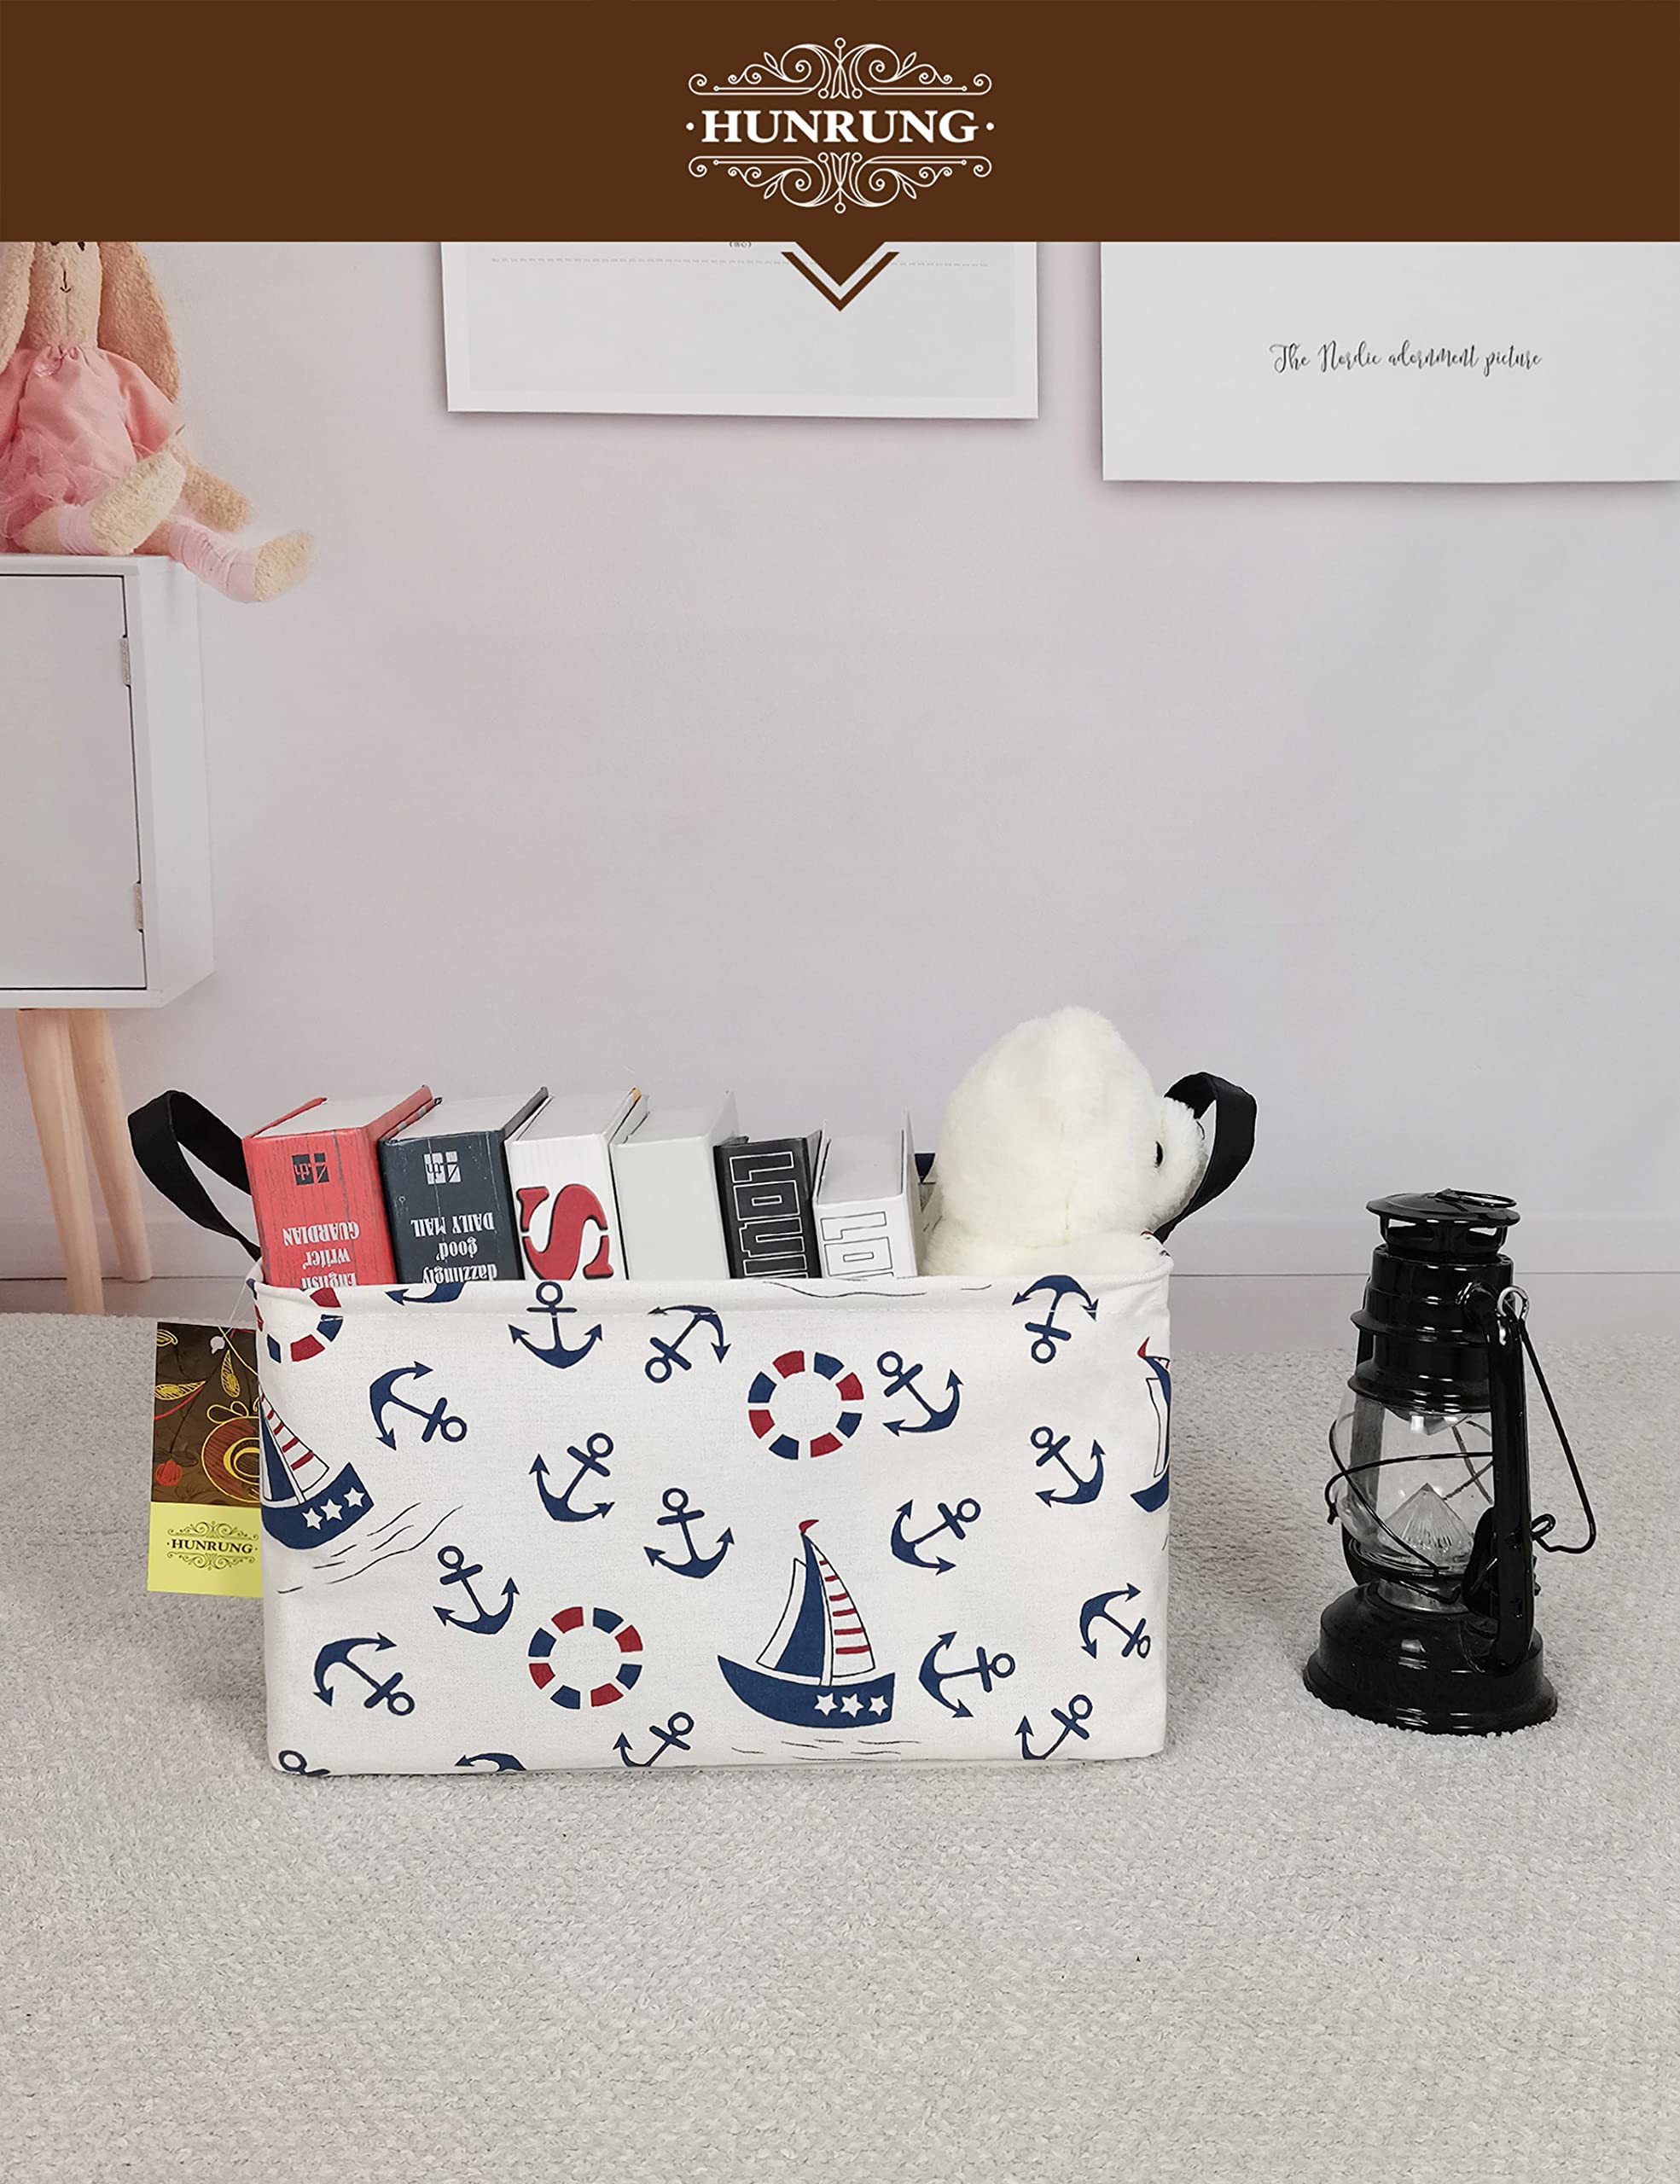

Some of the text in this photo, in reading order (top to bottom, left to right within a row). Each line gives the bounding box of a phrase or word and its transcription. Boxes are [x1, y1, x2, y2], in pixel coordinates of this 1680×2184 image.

[1270, 339, 1543, 377] The Nordic adornment picture
[410, 1211, 495, 1237] DAILY MAIL
[730, 1152, 808, 1278] LOUI
[282, 1221, 360, 1246] GUARDIAN
[171, 1538, 253, 1554] HUNRUNG
